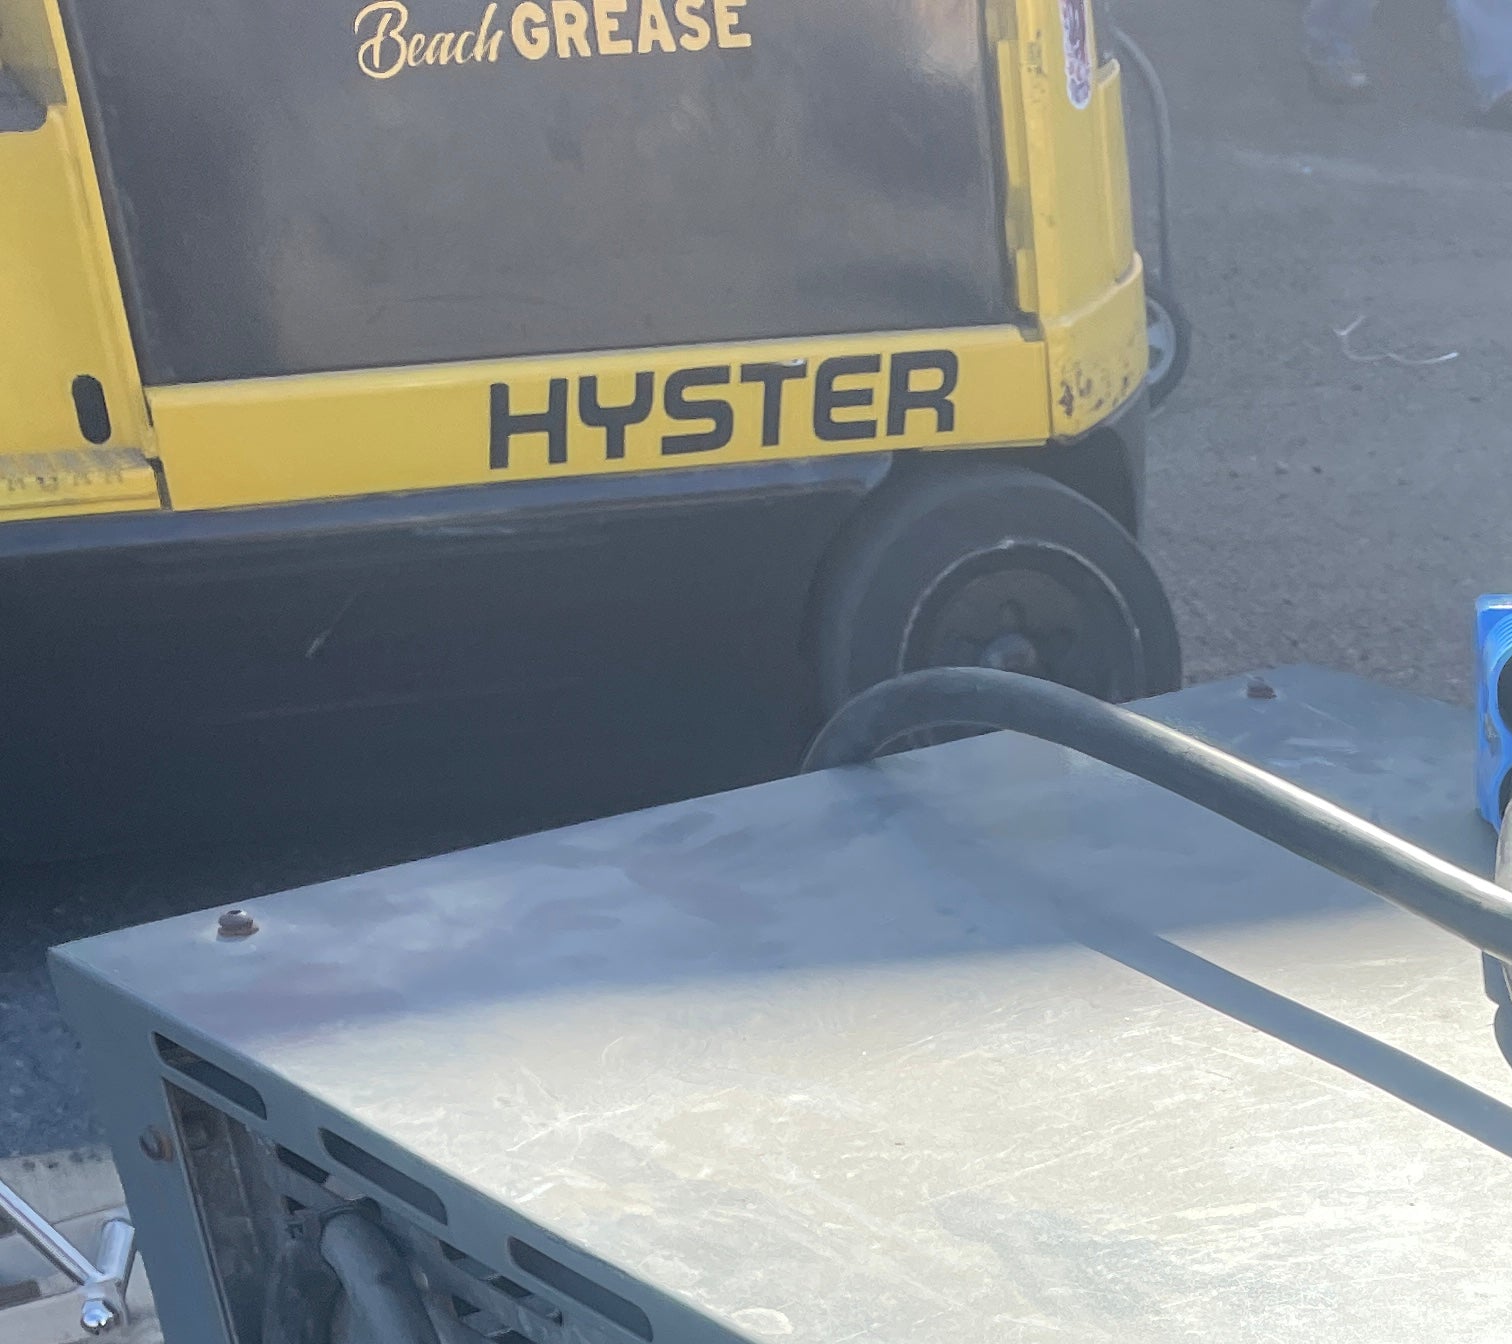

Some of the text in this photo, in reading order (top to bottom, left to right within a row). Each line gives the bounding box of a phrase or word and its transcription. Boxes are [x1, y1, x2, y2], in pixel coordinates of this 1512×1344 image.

[354, 0, 753, 79] Beach GREASE
[489, 348, 959, 470] HYSTER
